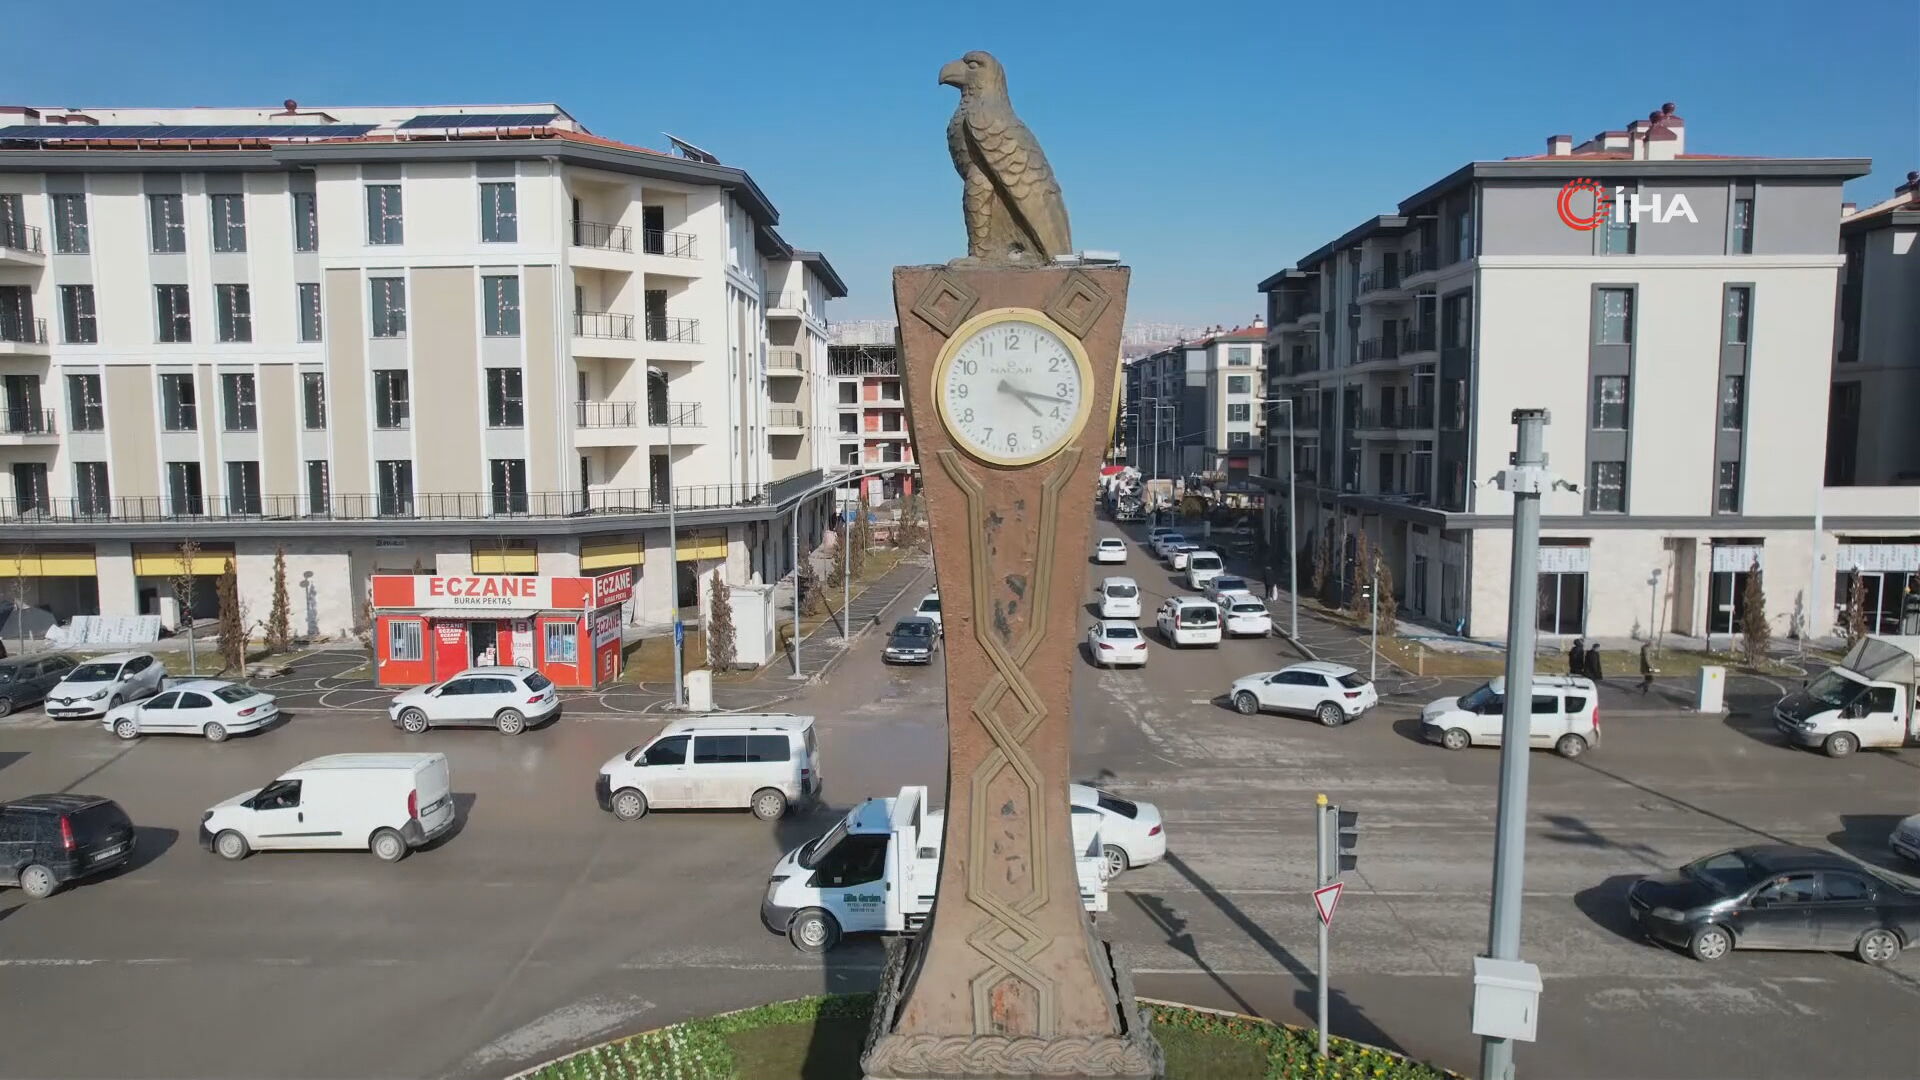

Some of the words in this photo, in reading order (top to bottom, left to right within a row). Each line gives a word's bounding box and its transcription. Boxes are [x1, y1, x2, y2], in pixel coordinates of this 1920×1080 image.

[982, 342, 993, 357] 11
[1004, 335, 1020, 350] 12
[1034, 336, 1039, 354] 1
[963, 360, 978, 375] 10
[1048, 357, 1060, 373] 2
[958, 384, 969, 398] 9
[1056, 383, 1068, 397] 3
[964, 408, 975, 423] 8
[1050, 406, 1060, 420] 4
[984, 428, 994, 442] 7
[1007, 433, 1018, 447] 6
[1032, 425, 1043, 440] 5
[430, 577, 537, 596] ECZANE
[596, 572, 630, 597] ECZANE
[454, 597, 481, 605] BURAK
[517, 623, 525, 633] E
[596, 614, 620, 636] ECZANE
[606, 653, 611, 671] E
